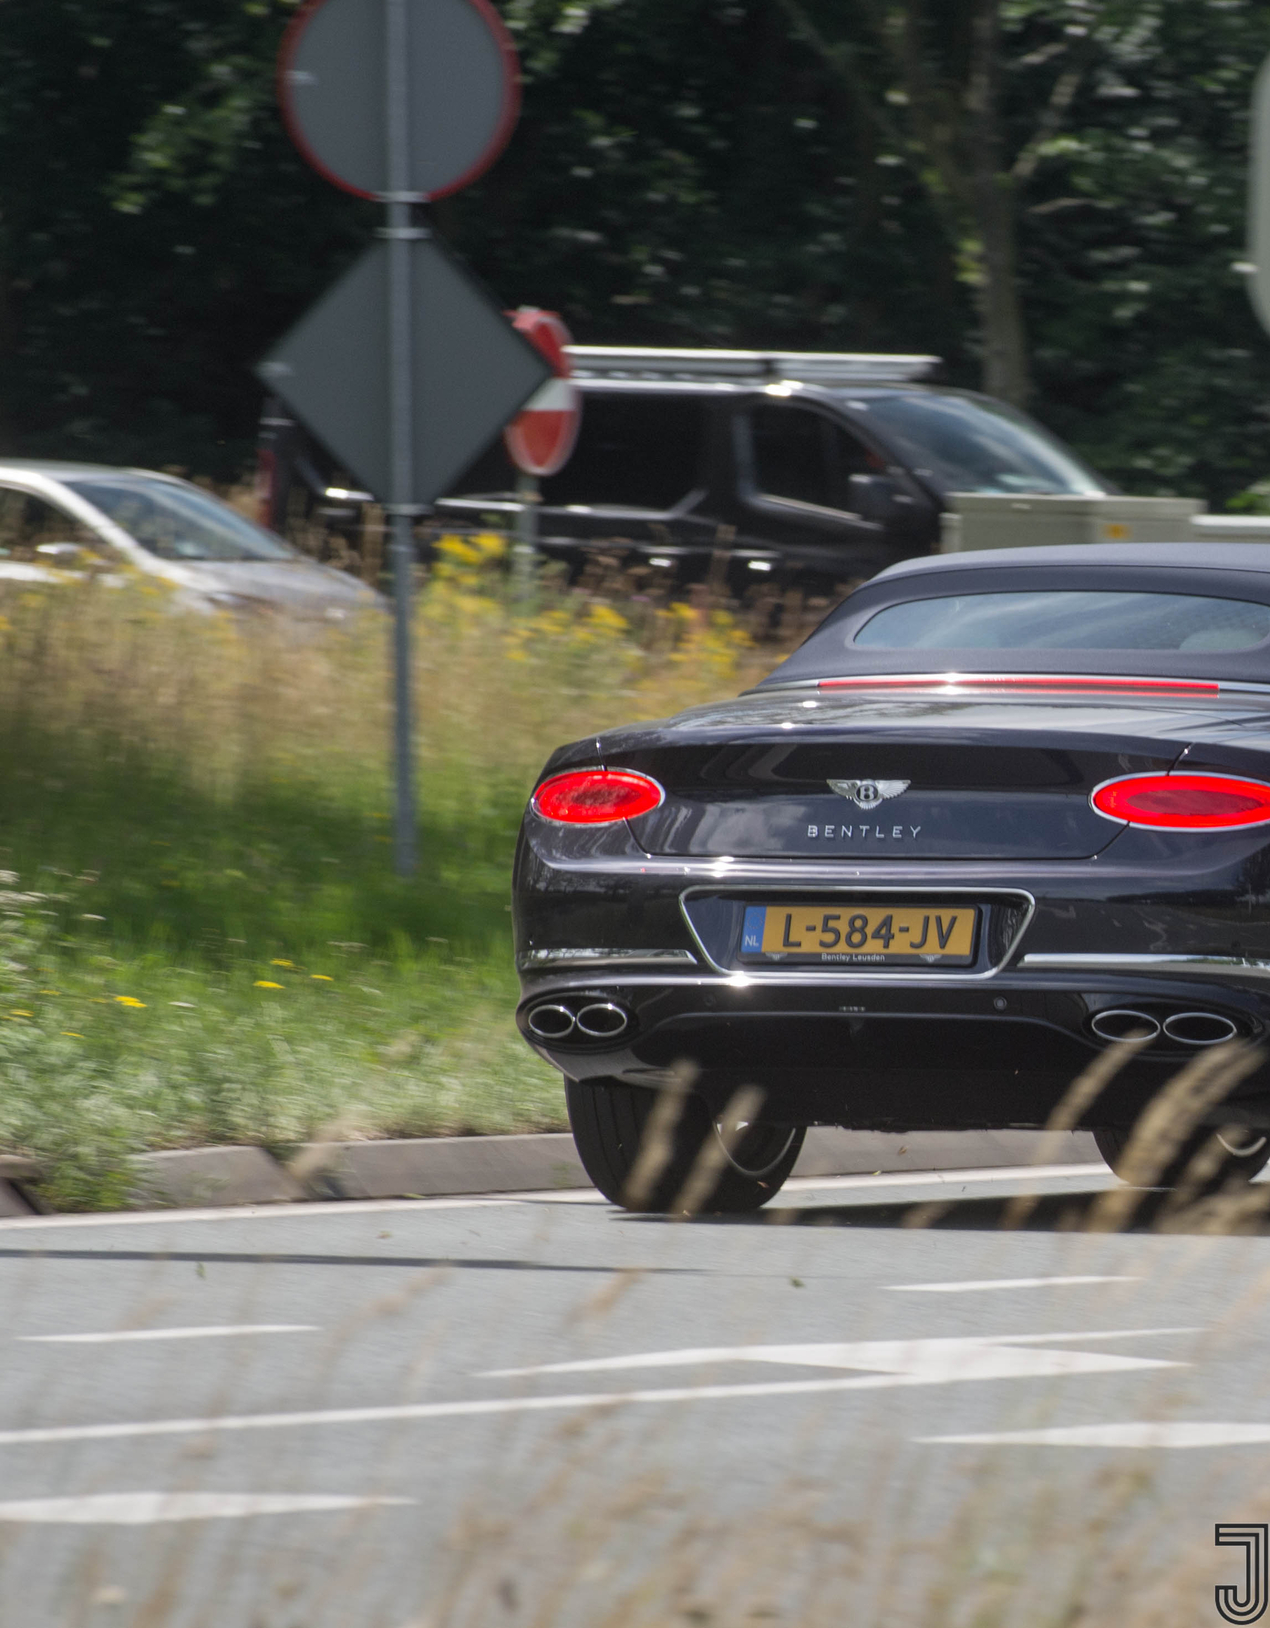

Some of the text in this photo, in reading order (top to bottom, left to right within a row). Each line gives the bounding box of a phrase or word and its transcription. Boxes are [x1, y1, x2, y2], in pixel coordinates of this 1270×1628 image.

[806, 824, 922, 839] BENTLEY
[782, 913, 958, 950] L-584-JV
[744, 935, 760, 947] NL
[821, 952, 886, 963] Bentley Leusden
